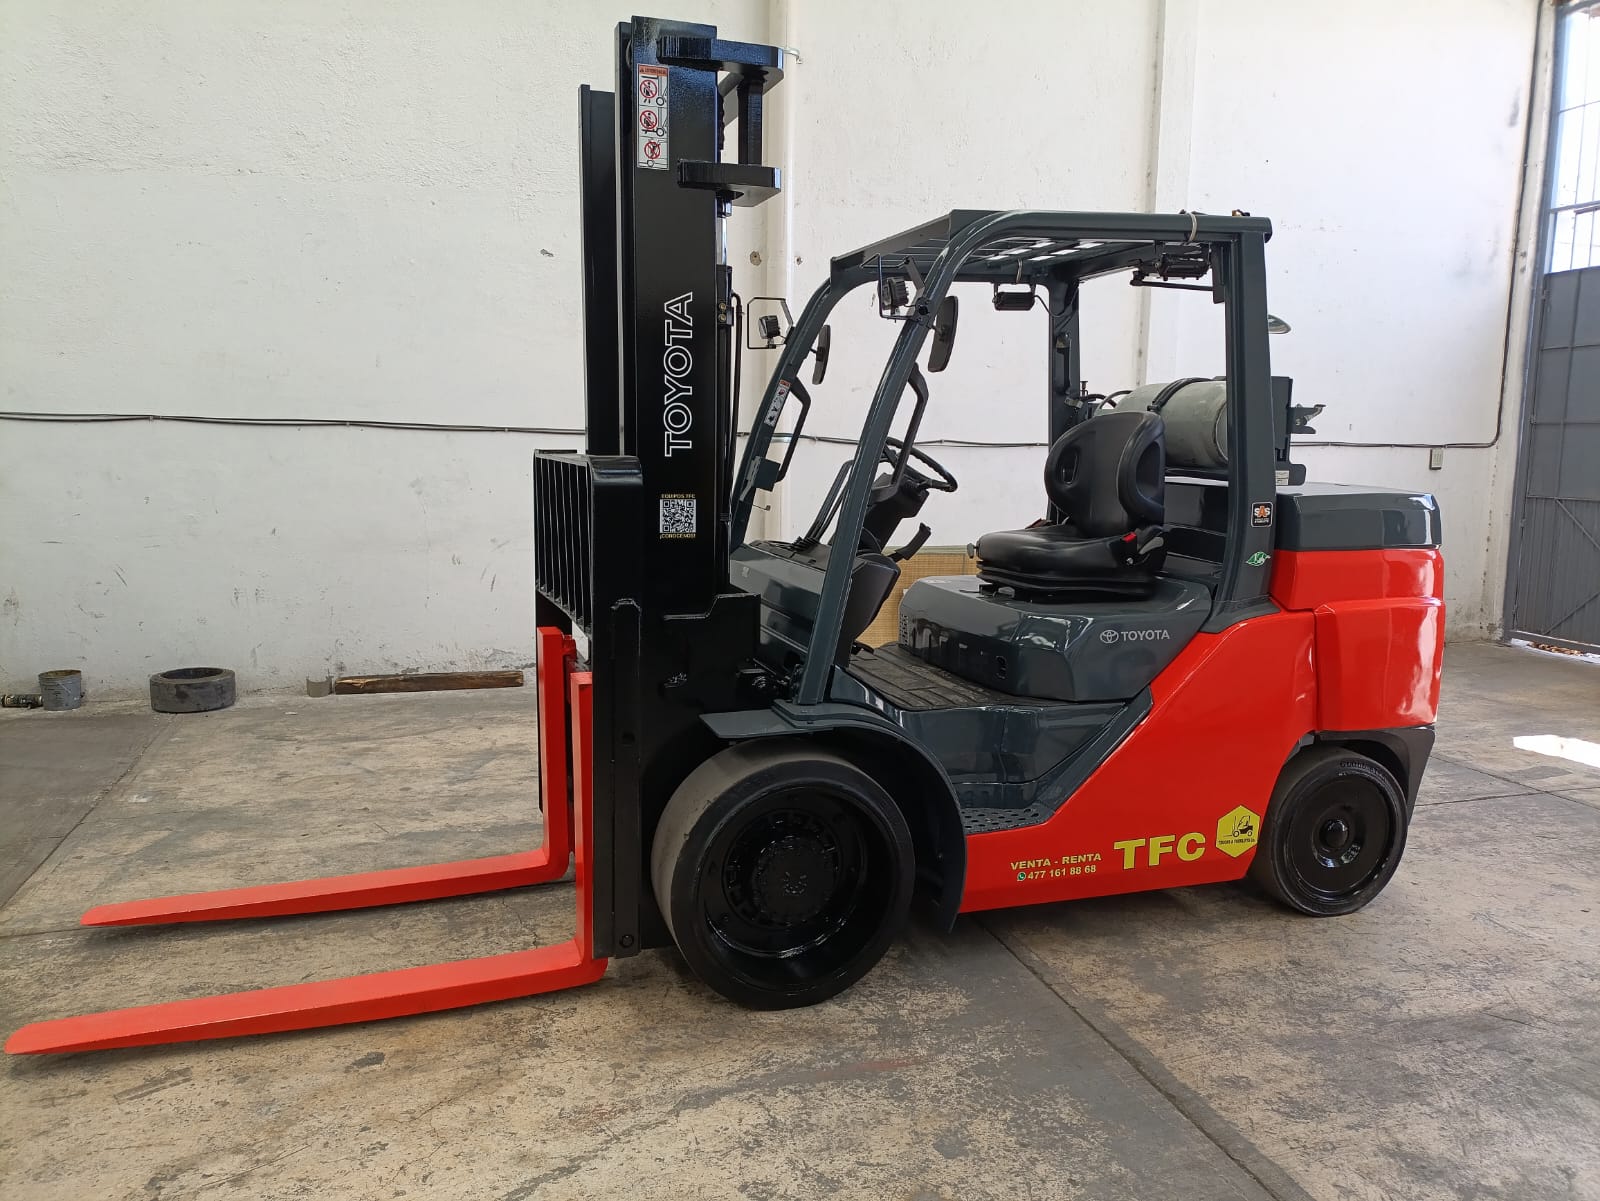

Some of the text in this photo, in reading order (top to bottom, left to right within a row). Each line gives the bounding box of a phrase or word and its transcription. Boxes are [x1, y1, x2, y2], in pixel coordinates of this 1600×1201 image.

[664, 292, 693, 457] TOYOTA
[1254, 505, 1271, 518] SAS
[1121, 630, 1170, 641] TOYOTA
[1113, 832, 1206, 870] TFC
[1010, 858, 1051, 870] VENTA
[1062, 853, 1101, 864] RENTA
[1028, 864, 1096, 879] 477 161 88 68
